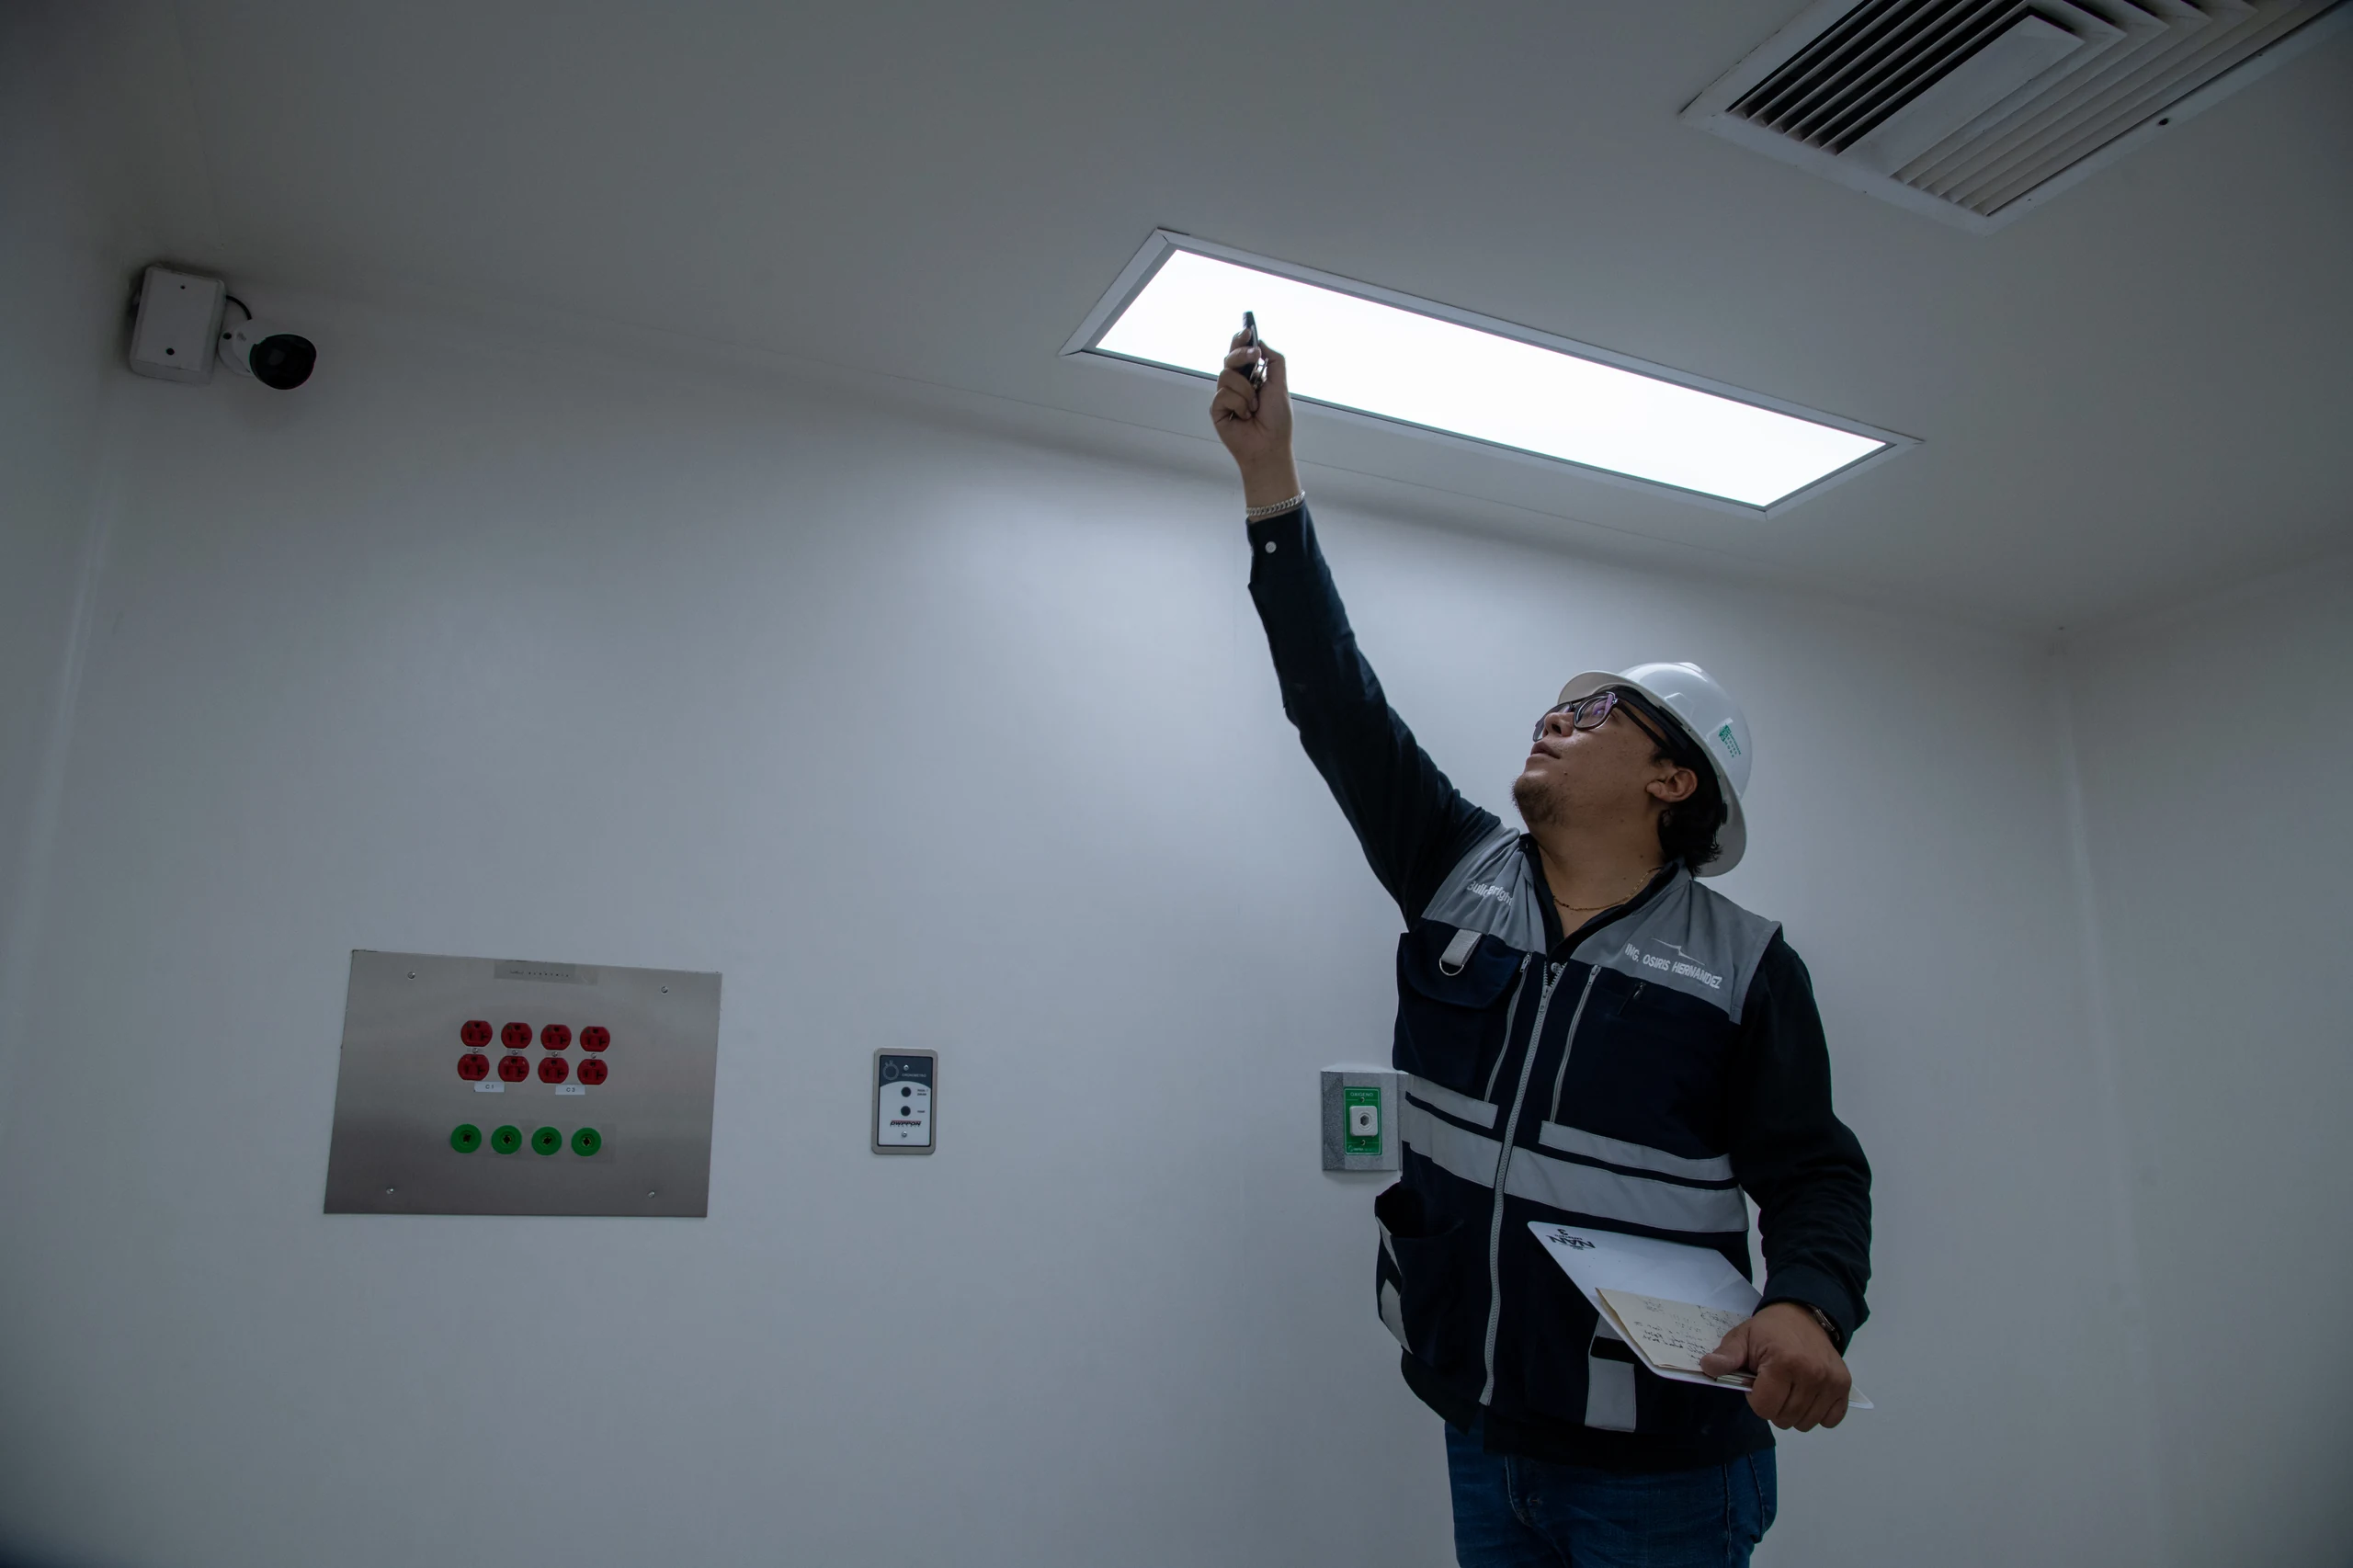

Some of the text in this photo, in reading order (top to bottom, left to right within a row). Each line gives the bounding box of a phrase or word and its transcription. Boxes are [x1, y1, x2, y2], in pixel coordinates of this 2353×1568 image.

[1625, 943, 1722, 989] ING. OSIRIS HERNANDEZ
